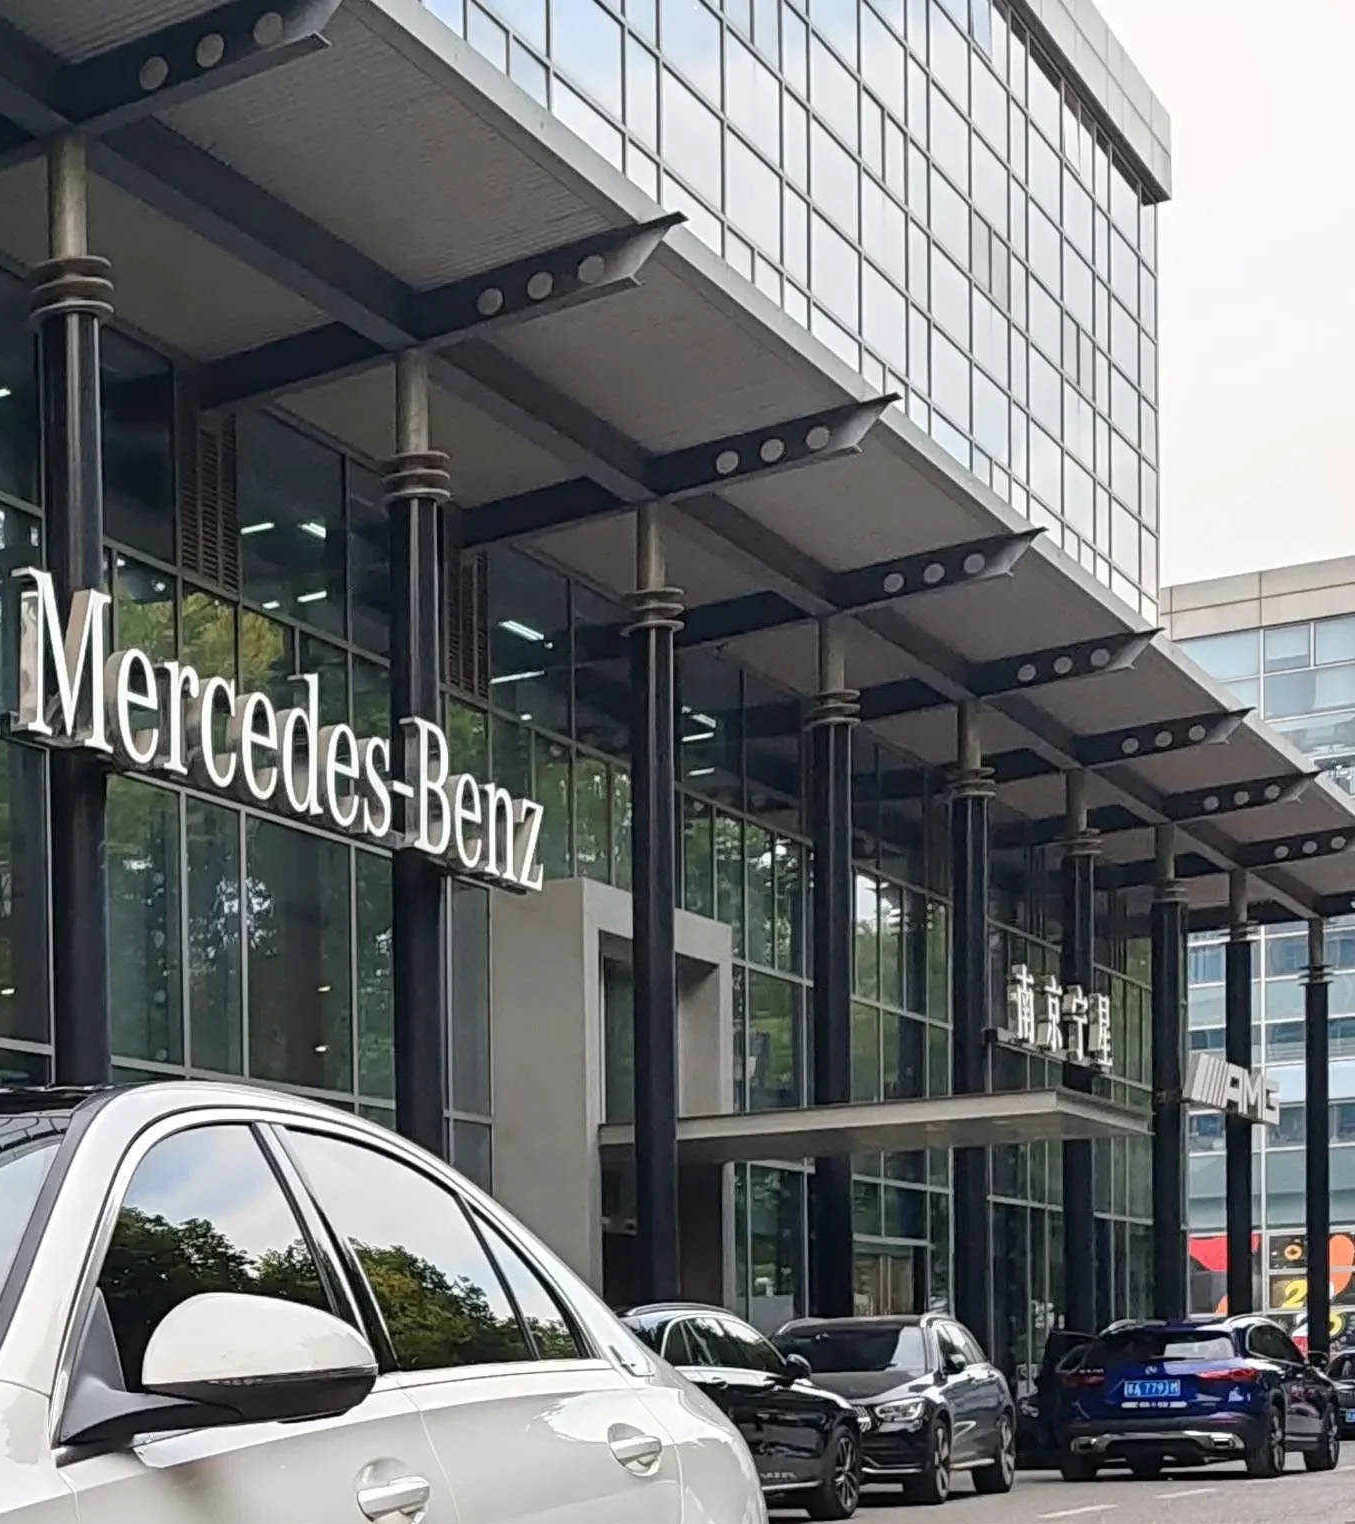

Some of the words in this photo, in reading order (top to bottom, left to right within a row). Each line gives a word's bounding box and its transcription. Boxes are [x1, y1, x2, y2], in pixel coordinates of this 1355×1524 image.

[13, 567, 545, 891] Mercedes-Benz
[1011, 964, 1113, 1067] 南京宁星
